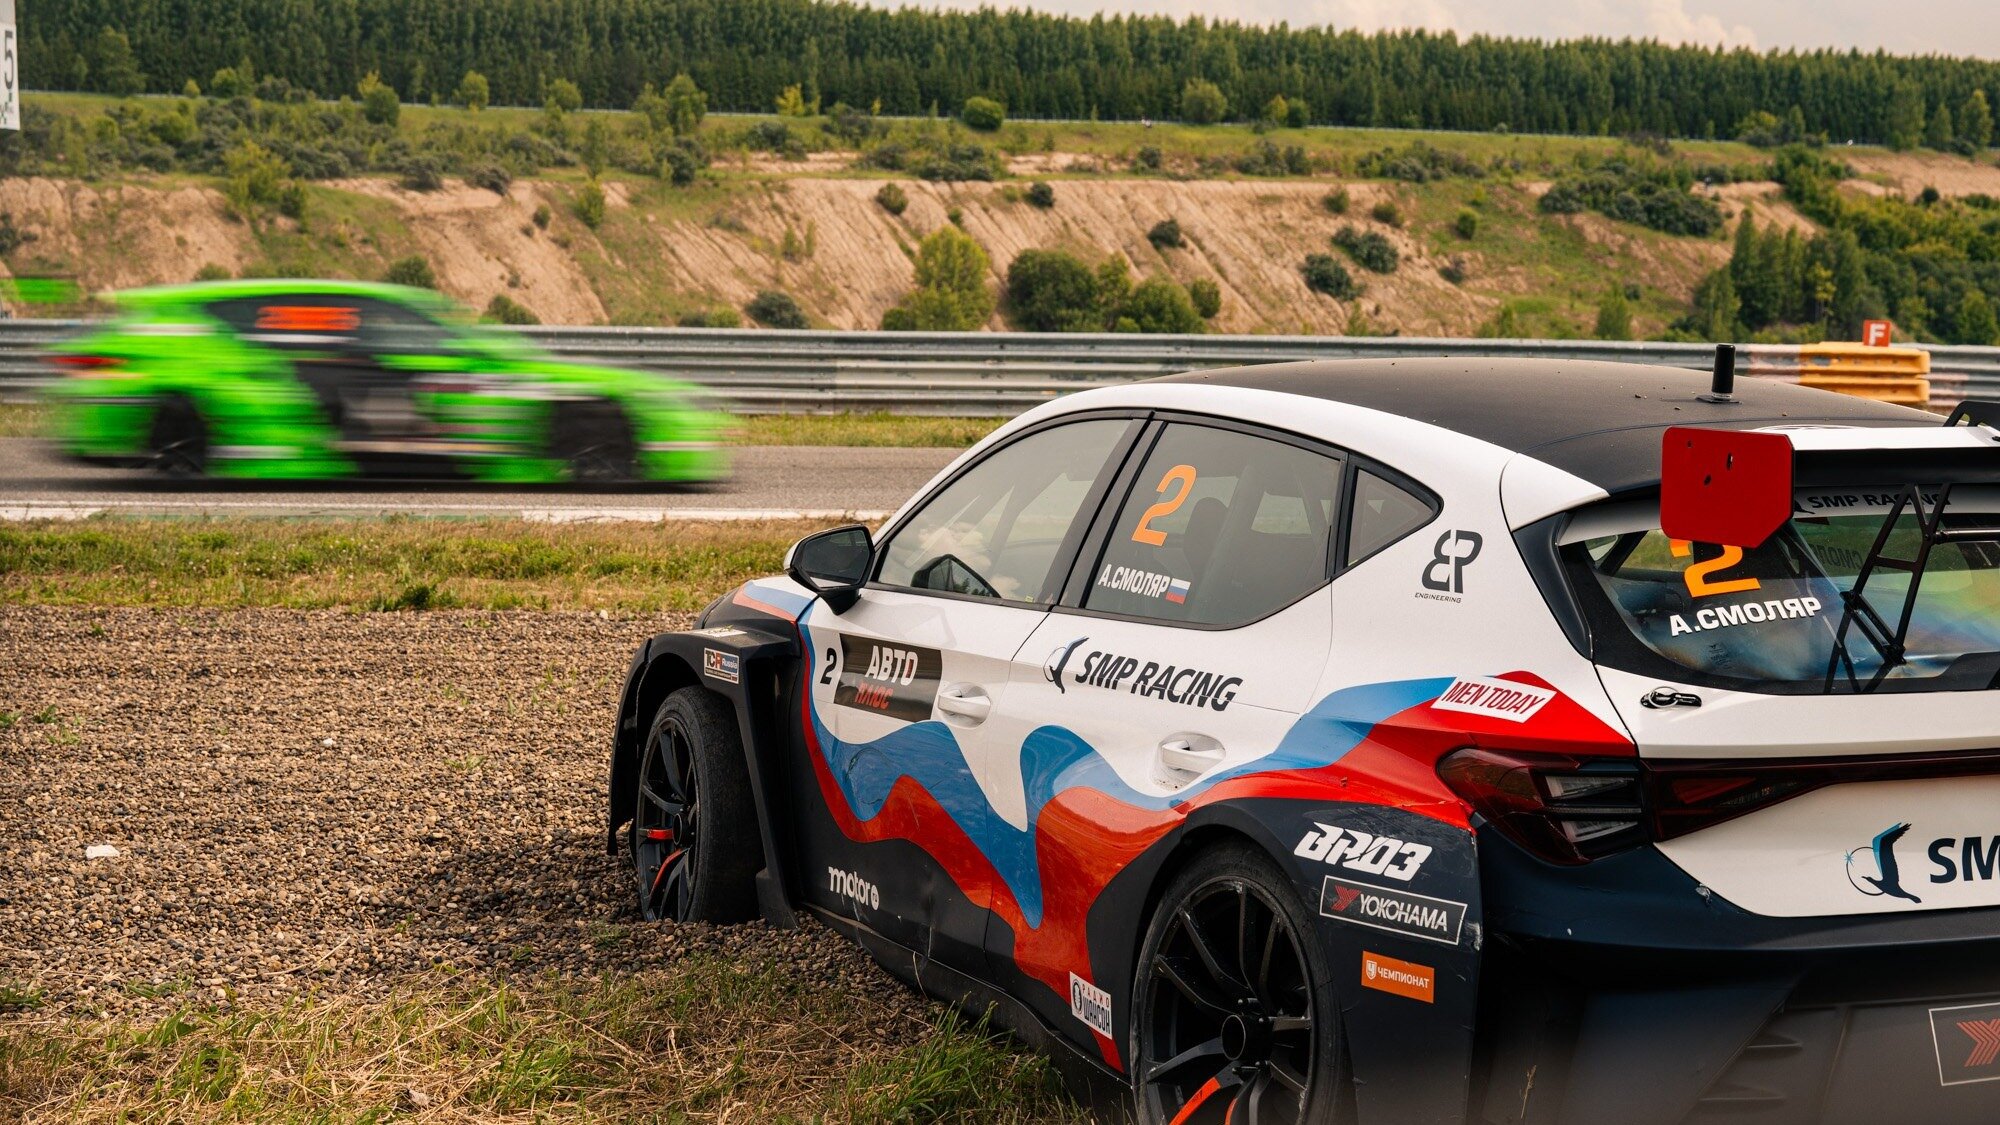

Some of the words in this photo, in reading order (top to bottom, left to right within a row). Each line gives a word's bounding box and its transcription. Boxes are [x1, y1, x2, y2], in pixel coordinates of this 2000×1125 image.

[1869, 323, 1886, 346] F
[1132, 465, 1196, 546] 2
[1807, 494, 1859, 508] SMP
[1098, 563, 1171, 599] А.СМОЛЯР
[1669, 538, 1761, 598] 2
[1415, 592, 1462, 604] ENGINEERING
[1669, 597, 1822, 637] А.СМОЛЯР
[820, 647, 838, 685] 2
[865, 645, 918, 686] АВТО
[1075, 650, 1139, 690] SMP
[1130, 661, 1243, 712] RACING
[1442, 681, 1486, 706] MEN
[1479, 687, 1545, 715] TODAY
[828, 866, 871, 906] motor
[1360, 894, 1448, 931] YOKOHAMA
[1377, 966, 1429, 988] ЧЕМПИОНАТ
[1083, 996, 1111, 1034] ШАНСОН
